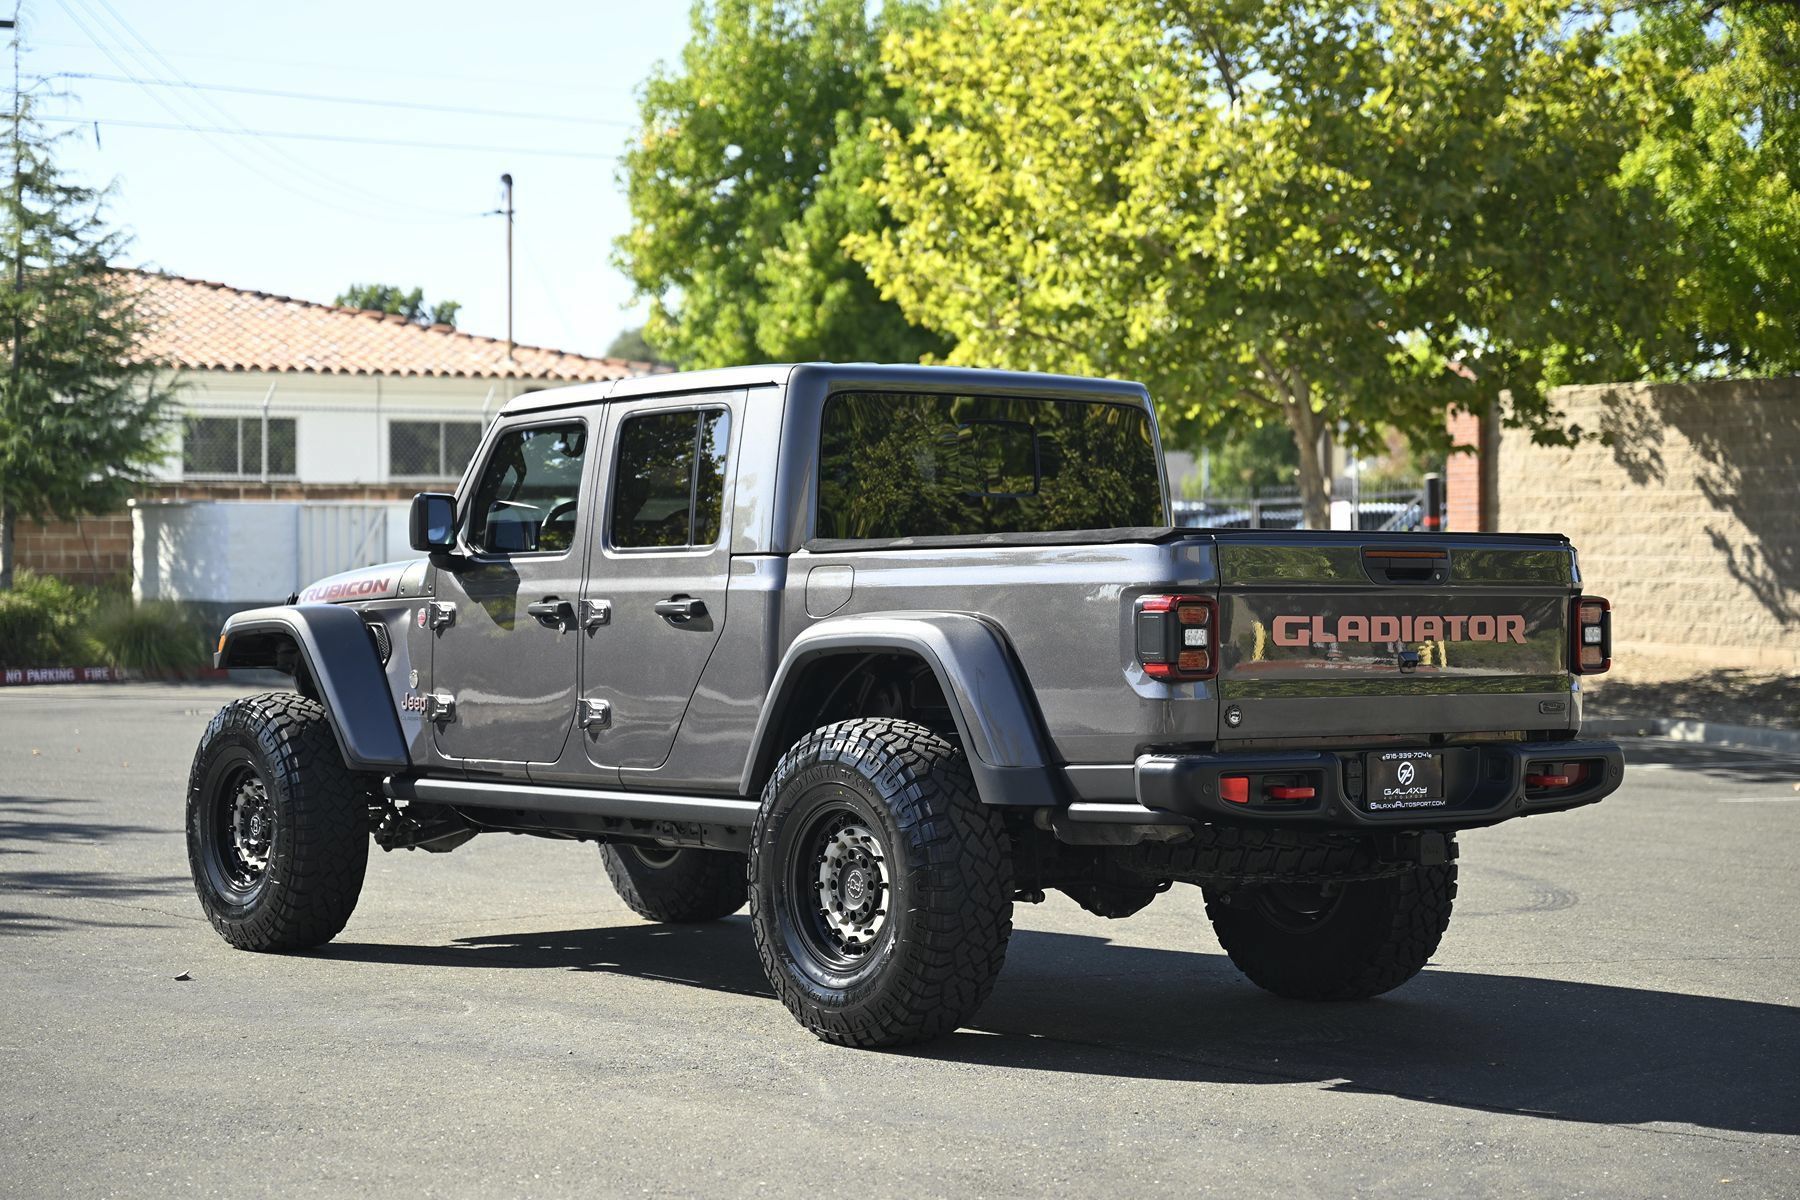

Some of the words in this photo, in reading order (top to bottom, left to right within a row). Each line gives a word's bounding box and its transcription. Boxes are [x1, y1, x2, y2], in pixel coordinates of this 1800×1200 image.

[302, 578, 390, 601] RUBICON
[1272, 614, 1528, 647] GLADIATOR
[5, 669, 22, 683] NO
[26, 667, 75, 682] PARKING
[84, 666, 110, 681] FIRE
[401, 692, 427, 715] Jeep
[1383, 787, 1428, 796] GALAXY
